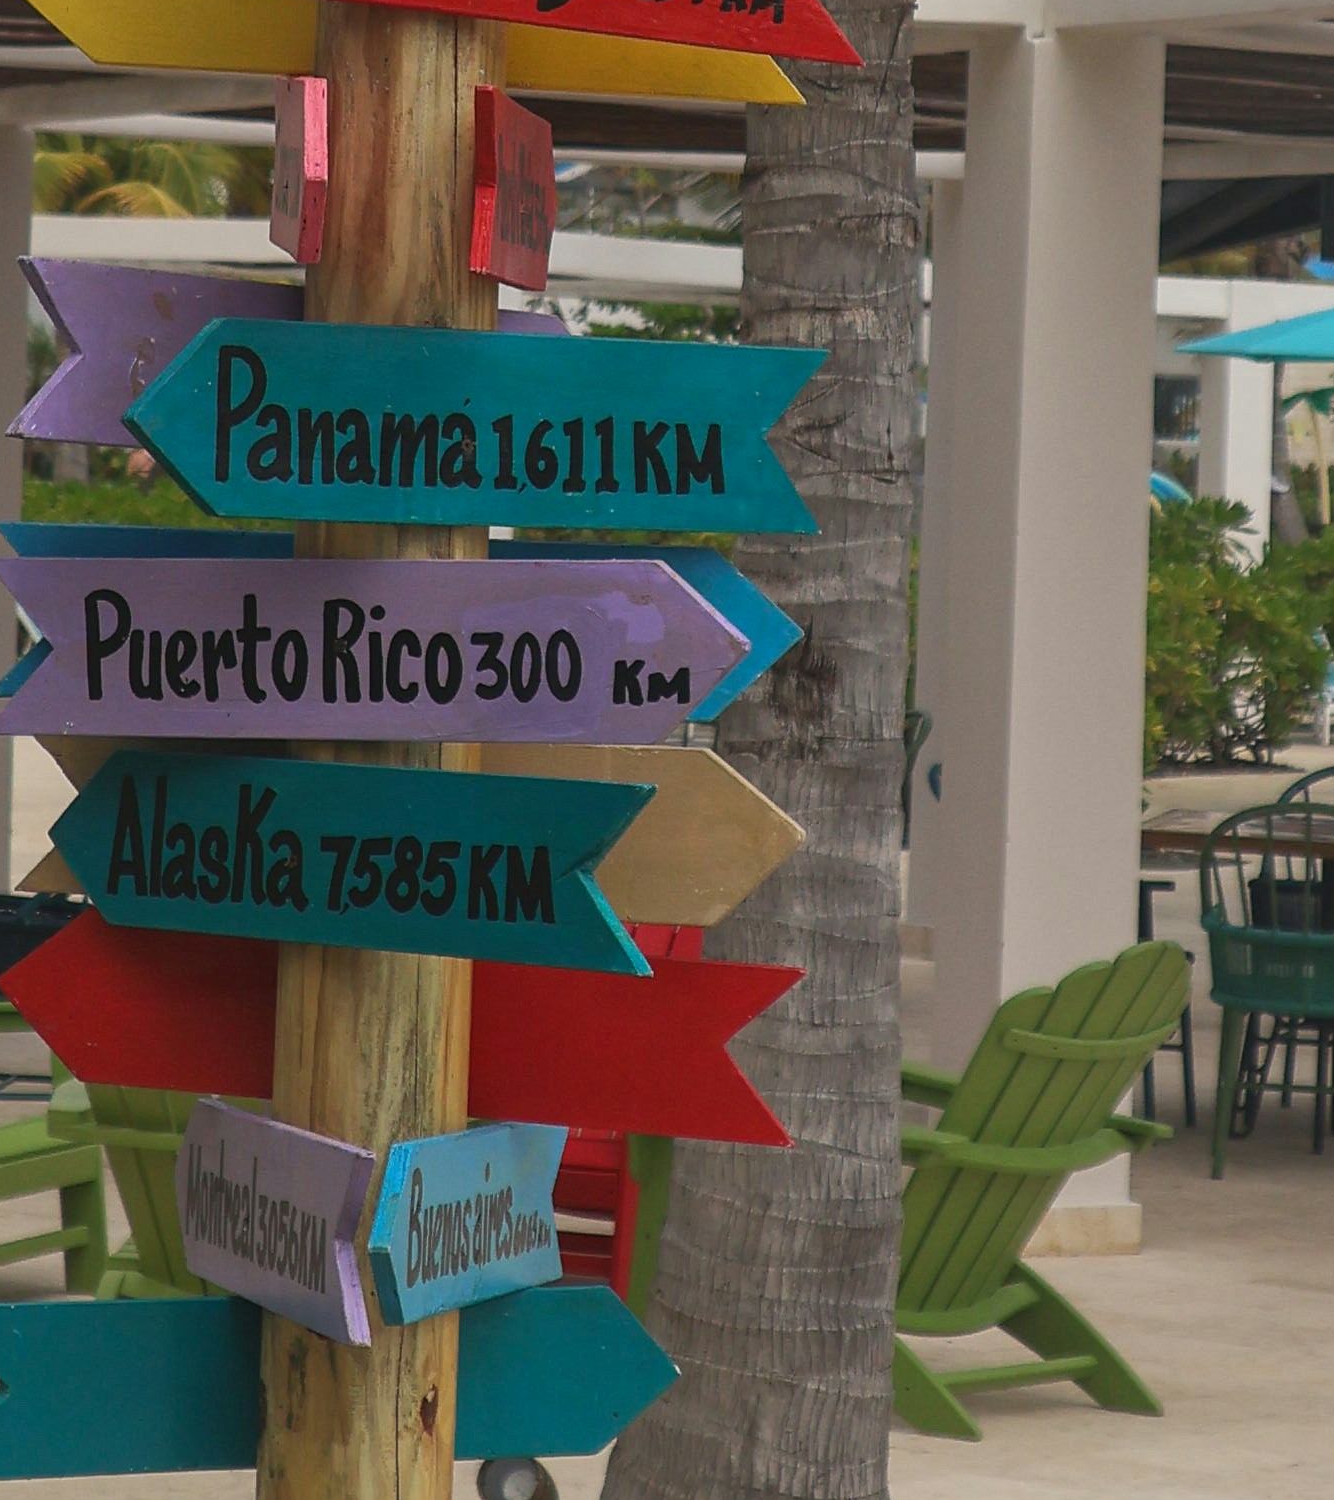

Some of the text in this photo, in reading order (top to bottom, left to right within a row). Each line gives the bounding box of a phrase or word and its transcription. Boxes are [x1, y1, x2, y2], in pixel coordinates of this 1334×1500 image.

[634, 421, 725, 494] KM
[84, 589, 308, 703] Puerto
[323, 598, 462, 704] Rico
[471, 629, 581, 703] 300
[467, 844, 555, 923] KM
[185, 1139, 257, 1262] Montreal
[298, 1211, 326, 1294] KM
[407, 1168, 472, 1288] Buenos
